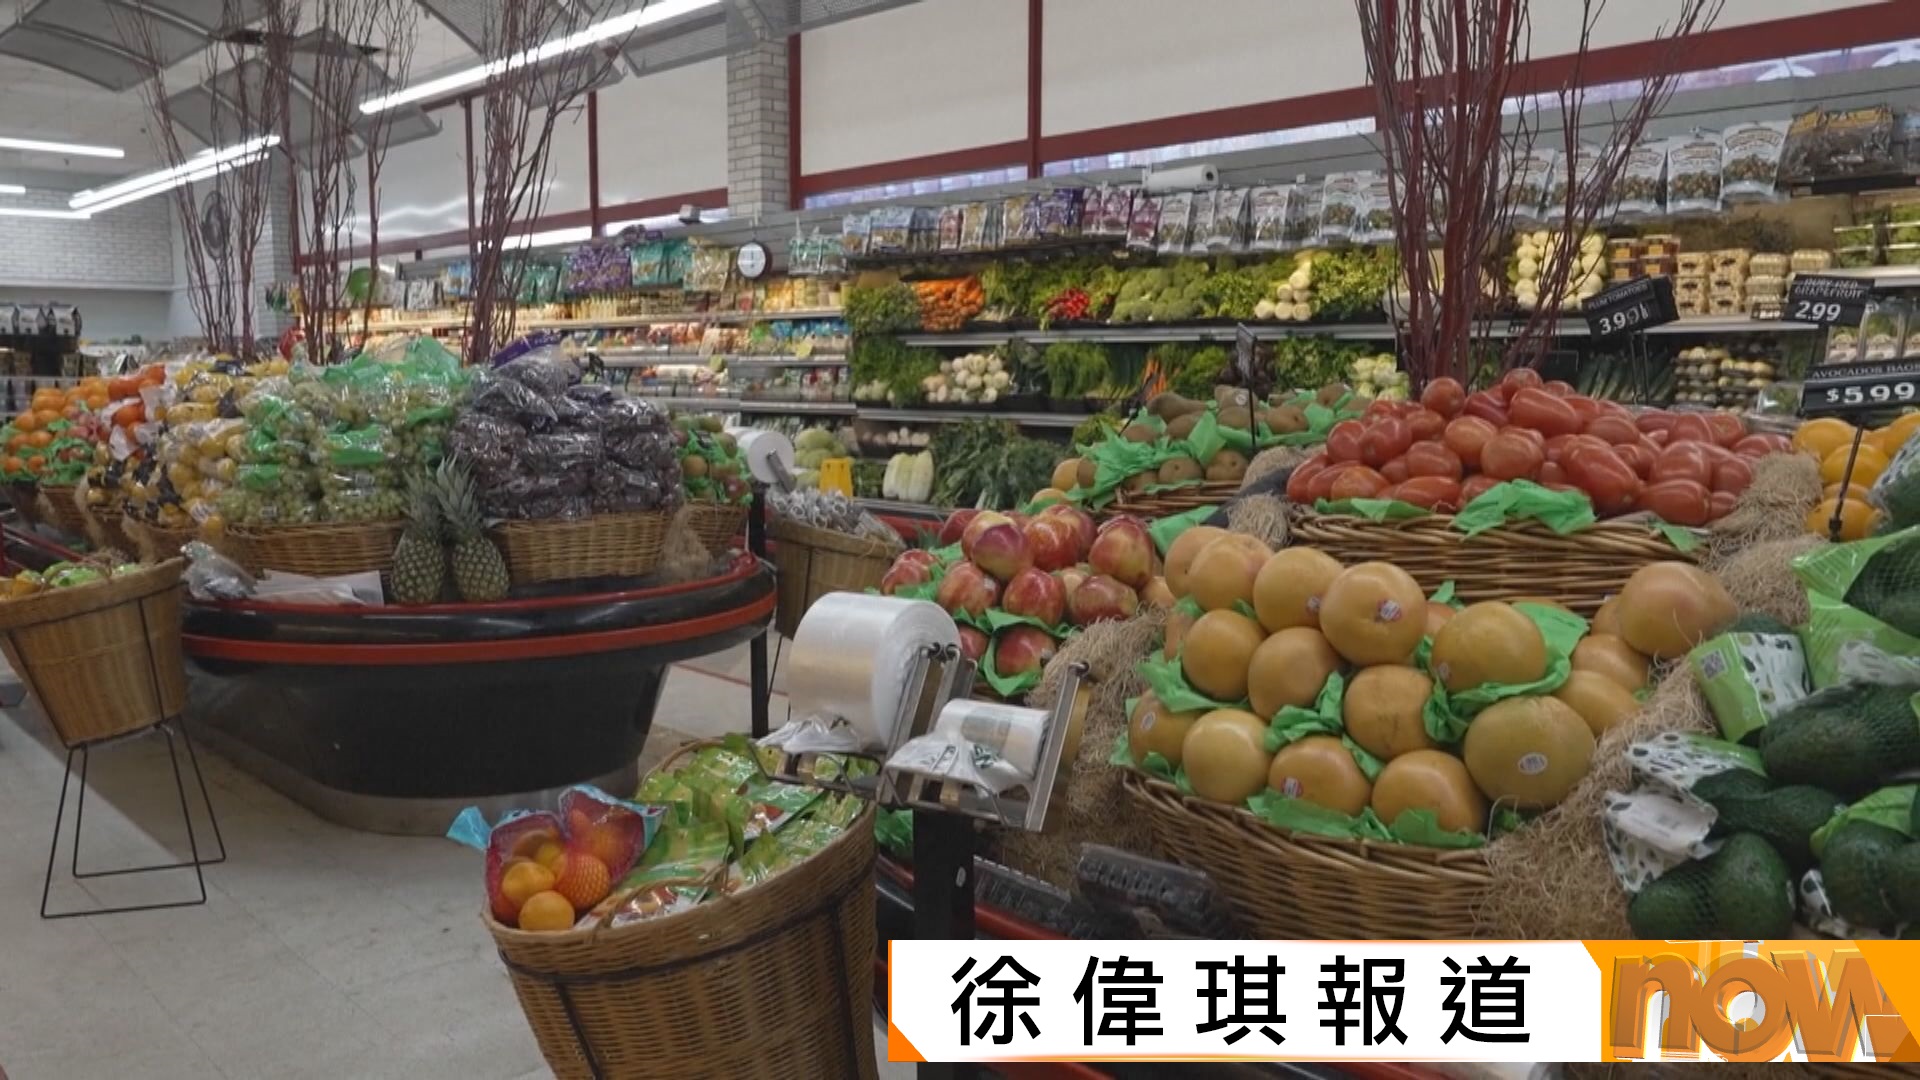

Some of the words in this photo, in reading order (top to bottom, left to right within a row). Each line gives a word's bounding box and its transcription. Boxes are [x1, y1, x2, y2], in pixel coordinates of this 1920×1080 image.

[1794, 286, 1865, 299] GRAPEFRUIT
[1794, 300, 1841, 321] 2.99
[1811, 365, 1883, 379] AVOCADOS
